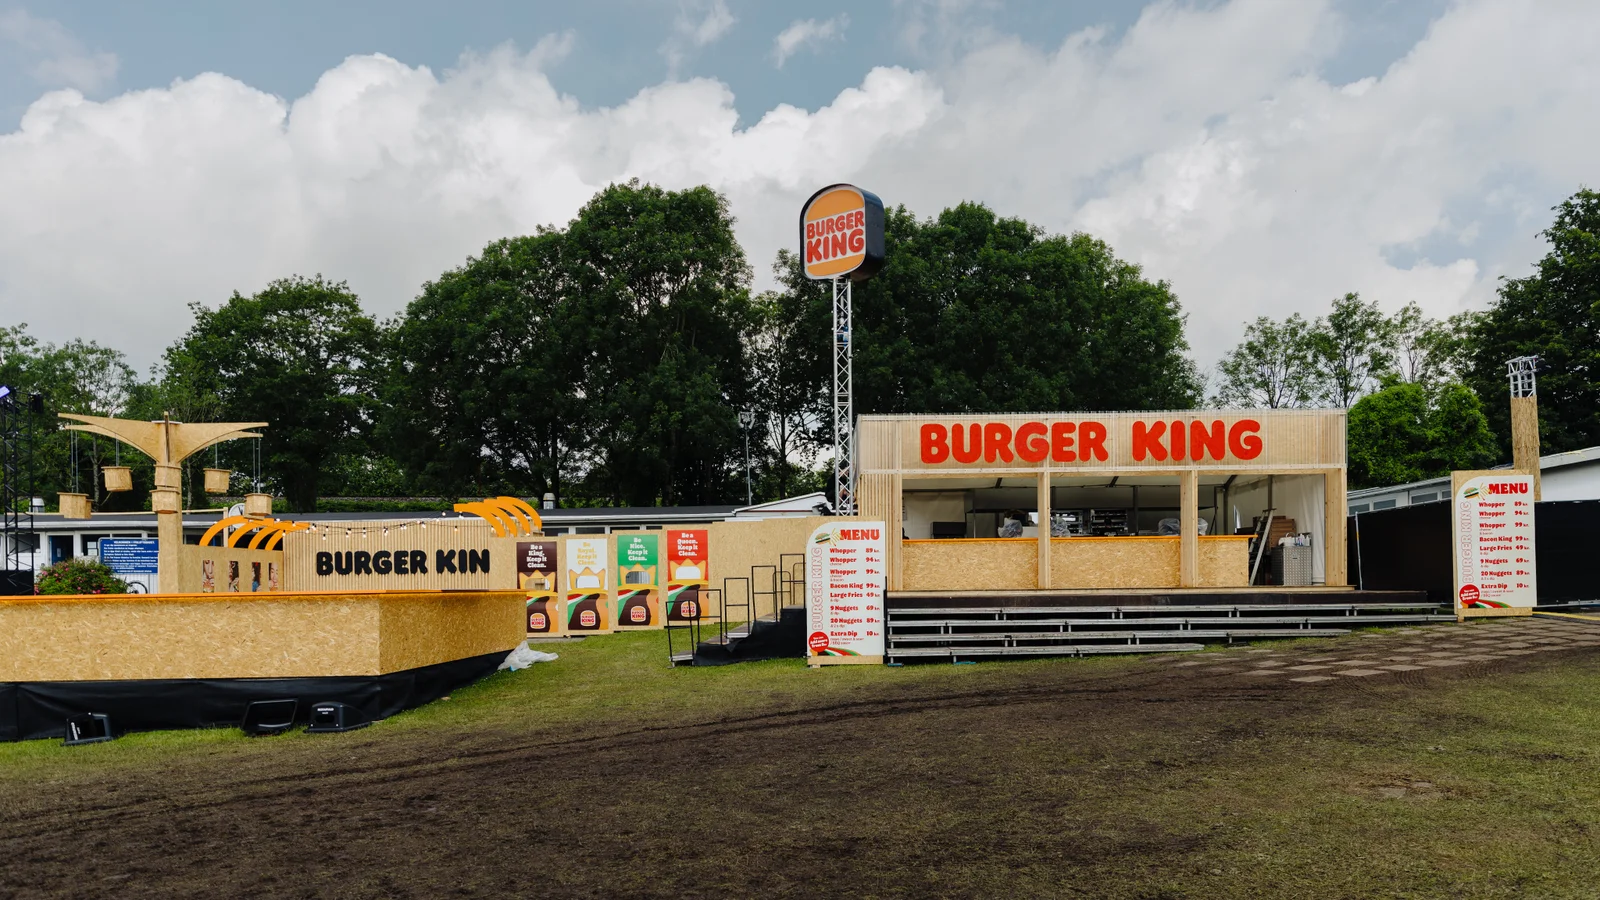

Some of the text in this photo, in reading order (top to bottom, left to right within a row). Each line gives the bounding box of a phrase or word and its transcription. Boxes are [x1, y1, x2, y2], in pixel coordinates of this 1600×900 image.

[807, 211, 864, 239] BURGER
[807, 229, 864, 263] KING
[920, 420, 1263, 463] BURGER KING
[1489, 483, 1528, 494] MENU
[1460, 502, 1472, 532] KING
[840, 529, 880, 540] MENU
[316, 549, 490, 576] BURGER KIN
[811, 548, 822, 578] KING
[1461, 534, 1474, 583] BURGER
[812, 581, 823, 630] BURGER
